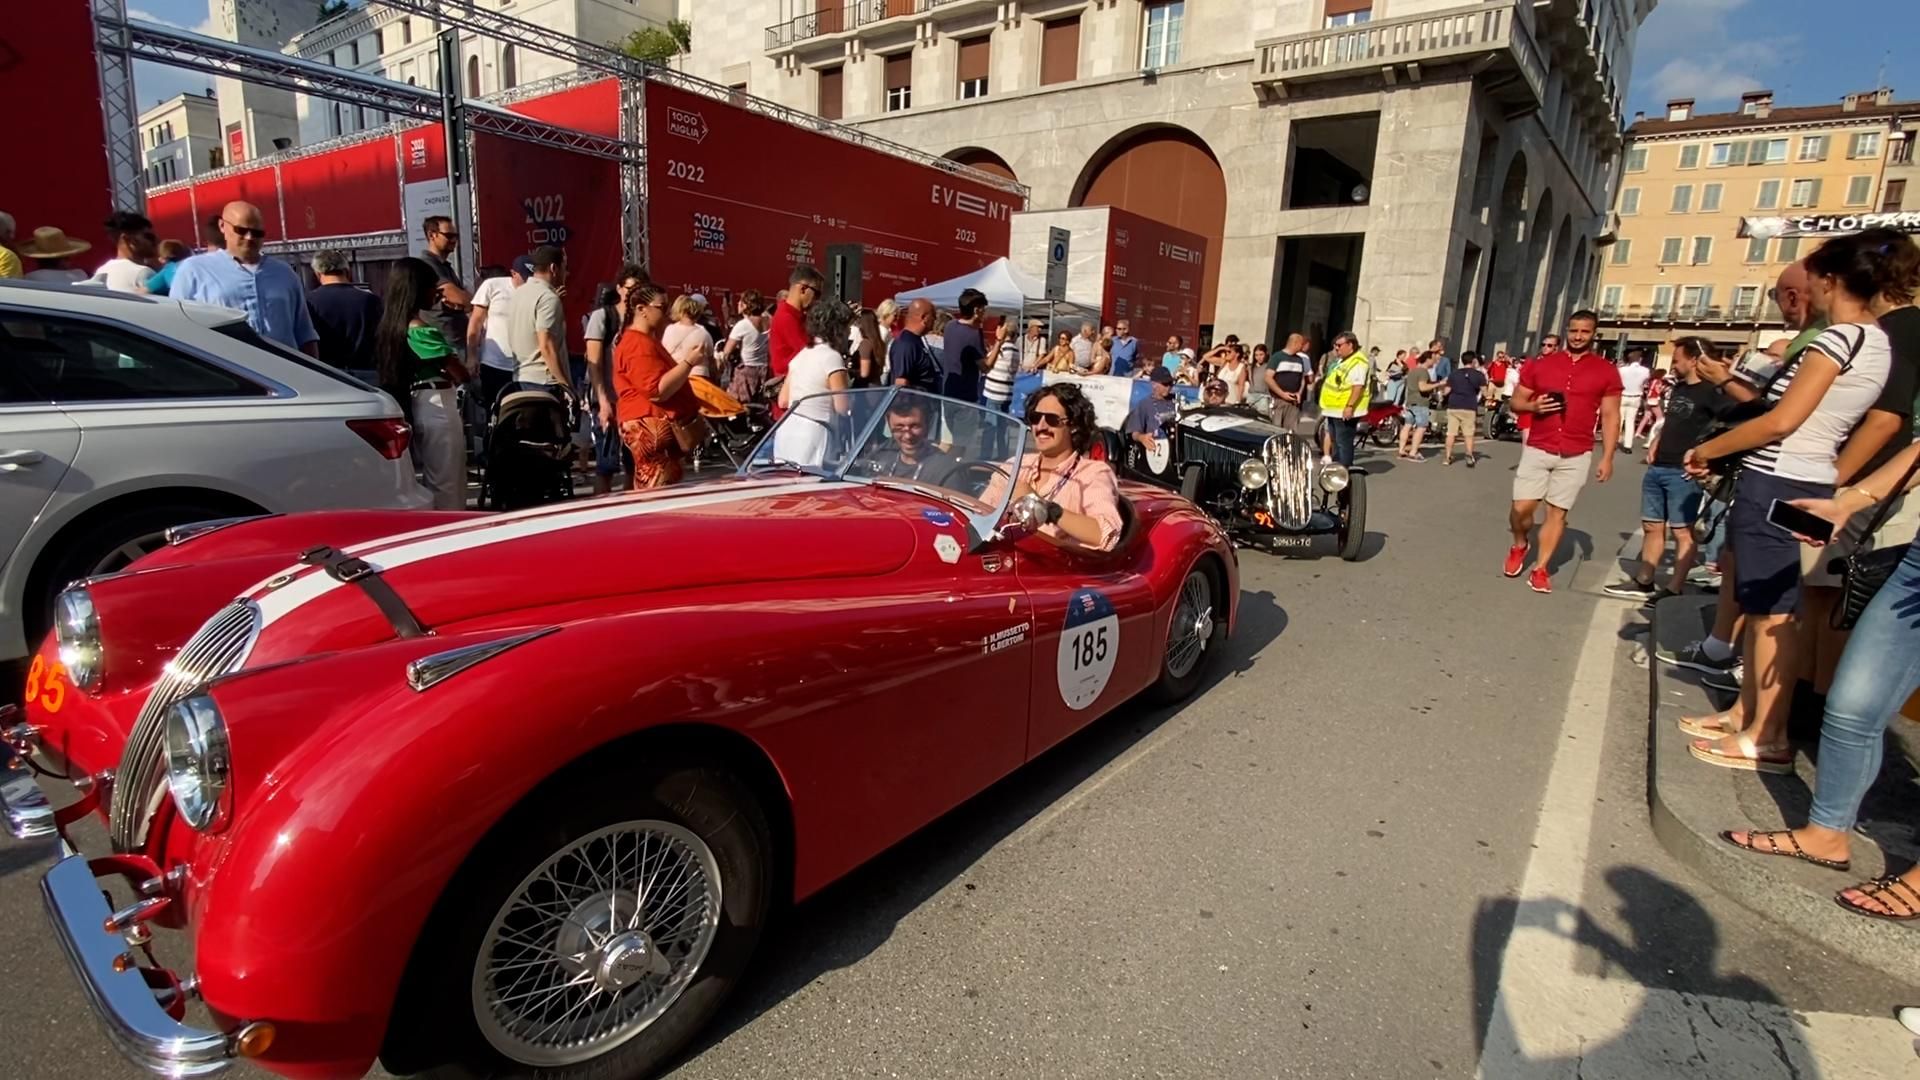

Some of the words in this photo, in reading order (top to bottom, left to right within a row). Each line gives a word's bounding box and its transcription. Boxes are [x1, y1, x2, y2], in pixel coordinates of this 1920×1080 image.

[671, 111, 698, 126] 1000
[670, 122, 699, 138] MIGLIA
[667, 159, 705, 183] 2022
[524, 193, 565, 224] 2022
[694, 212, 725, 231] 2022
[526, 227, 567, 244] 1000
[694, 229, 725, 241] 1000
[955, 228, 977, 244] 2023
[693, 239, 725, 251] MIGLIA
[1159, 241, 1202, 265] EVENTI
[1254, 512, 1275, 529] 92
[1072, 626, 1107, 671] 185
